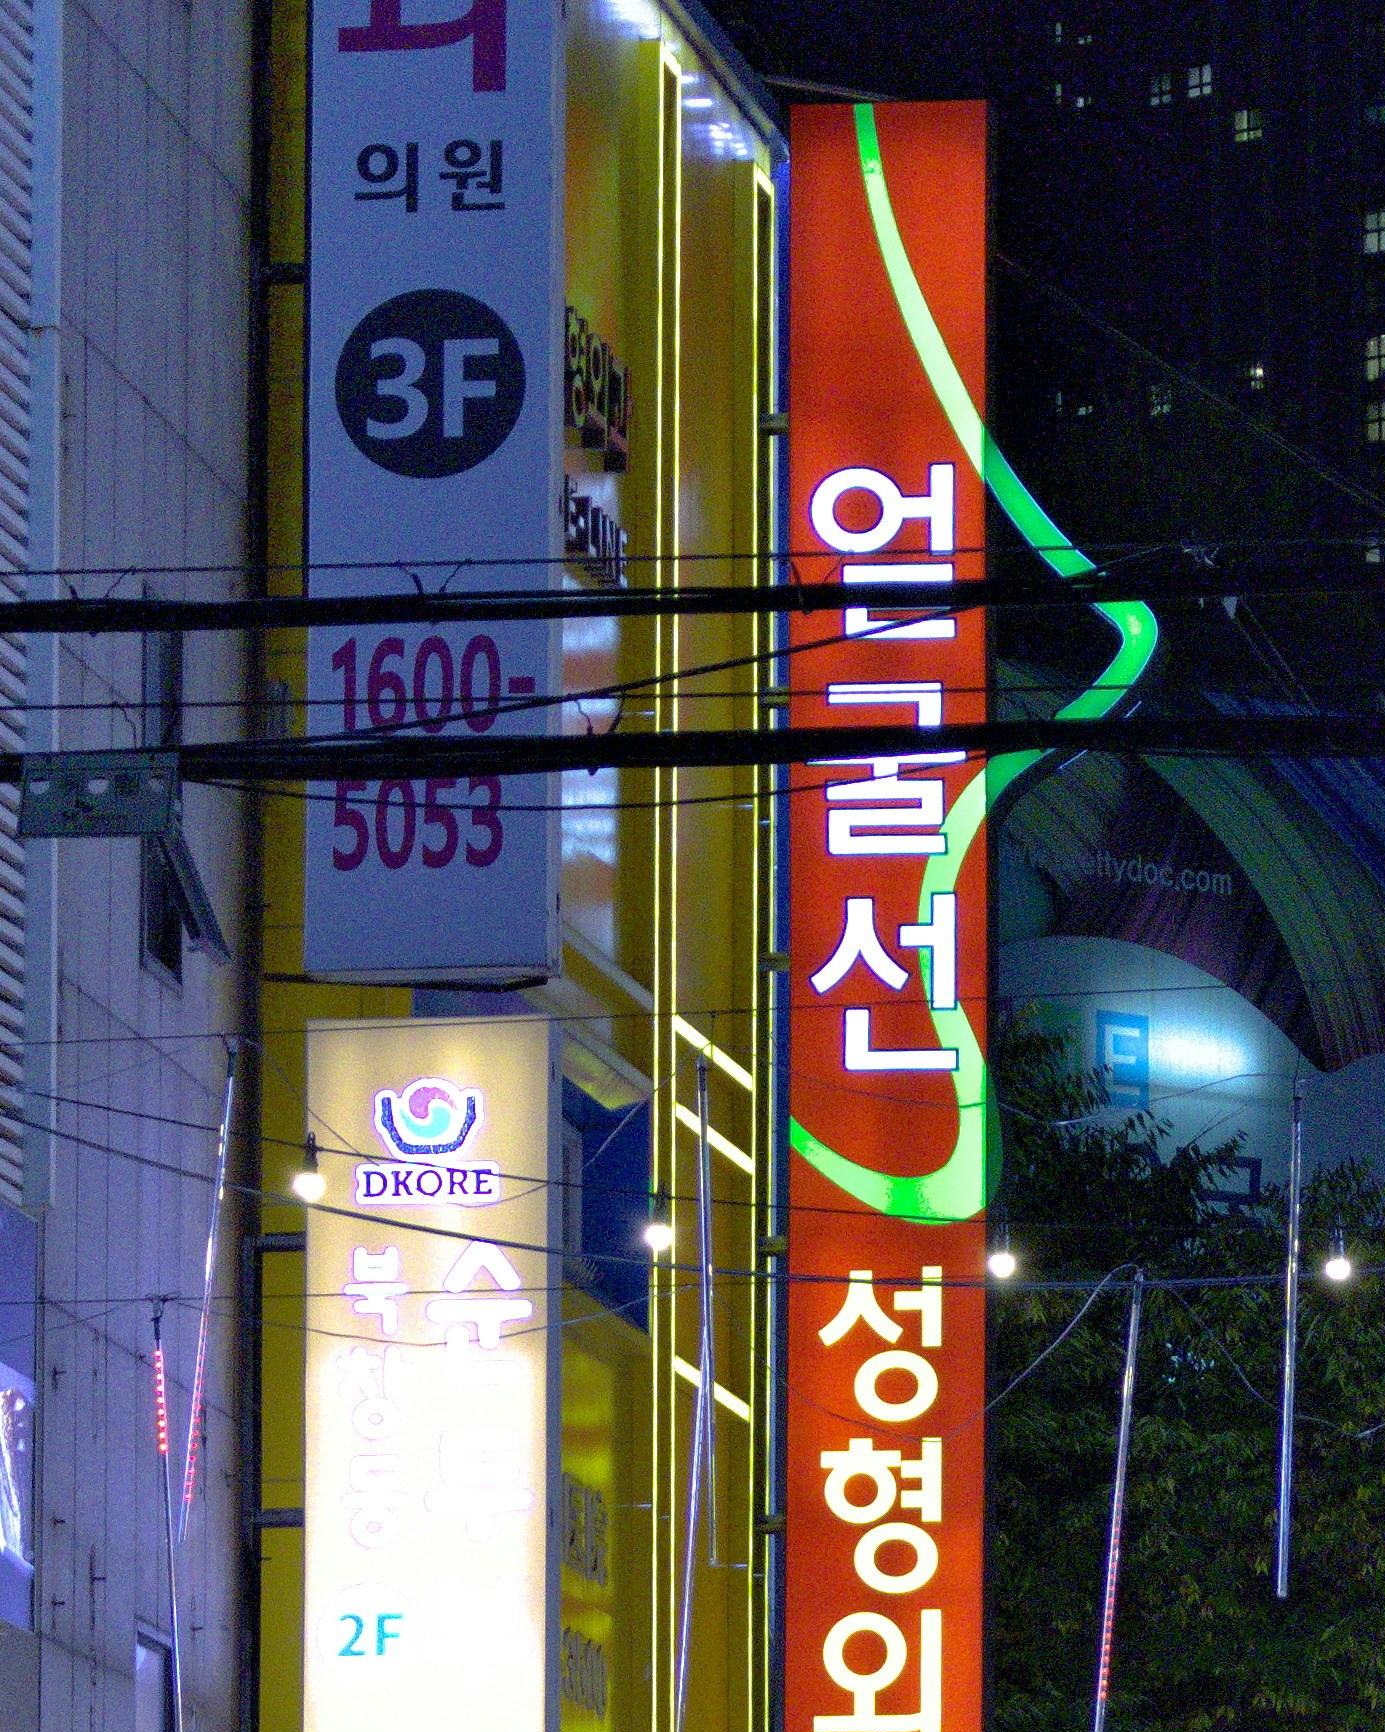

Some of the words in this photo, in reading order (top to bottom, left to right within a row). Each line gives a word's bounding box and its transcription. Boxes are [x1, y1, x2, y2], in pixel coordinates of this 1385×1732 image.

[354, 138, 507, 213] 의원
[364, 336, 501, 440] 3F
[331, 635, 537, 737] 1600-
[806, 462, 968, 1070] 얼굴선
[331, 768, 504, 870] 5053
[362, 1167, 493, 1198] DKORE
[337, 1611, 403, 1658] 2F
